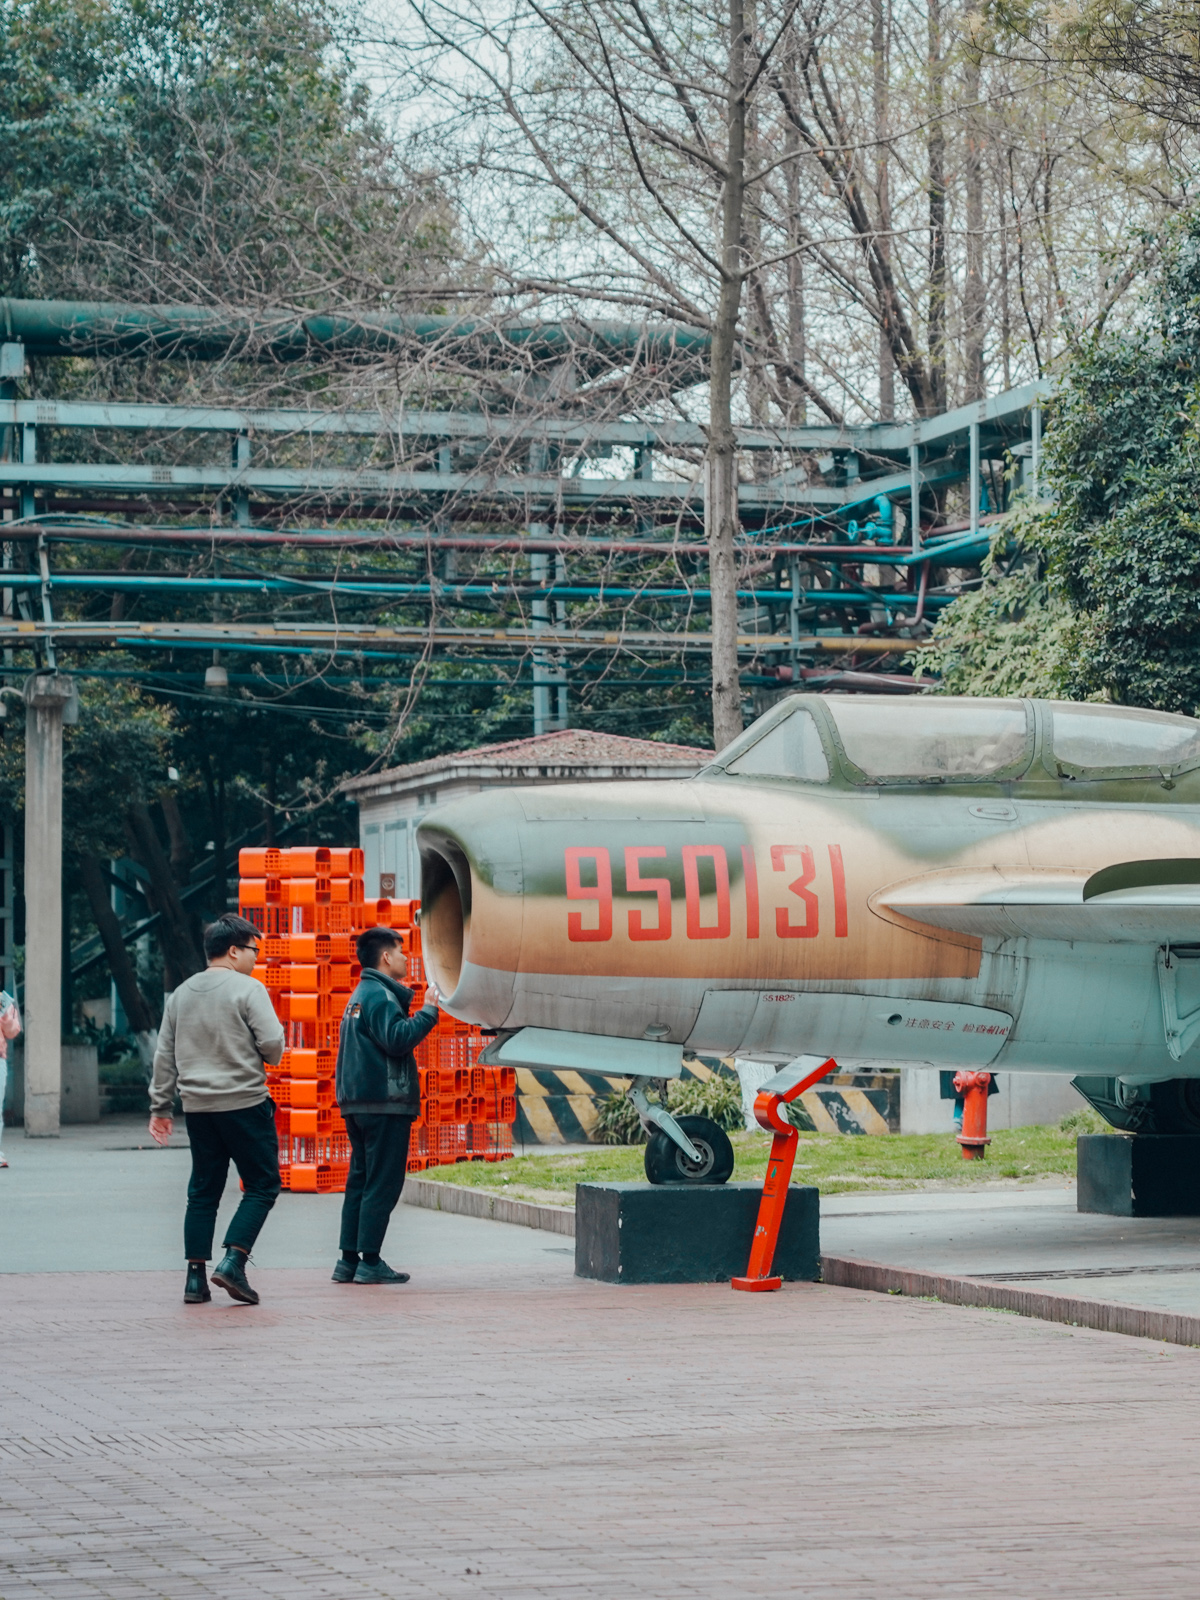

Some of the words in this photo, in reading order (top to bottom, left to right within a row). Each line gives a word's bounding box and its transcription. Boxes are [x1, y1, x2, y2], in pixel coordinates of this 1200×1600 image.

[564, 844, 849, 942] 950131
[762, 994, 796, 1002] 551825
[905, 1017, 955, 1031] 注意安全
